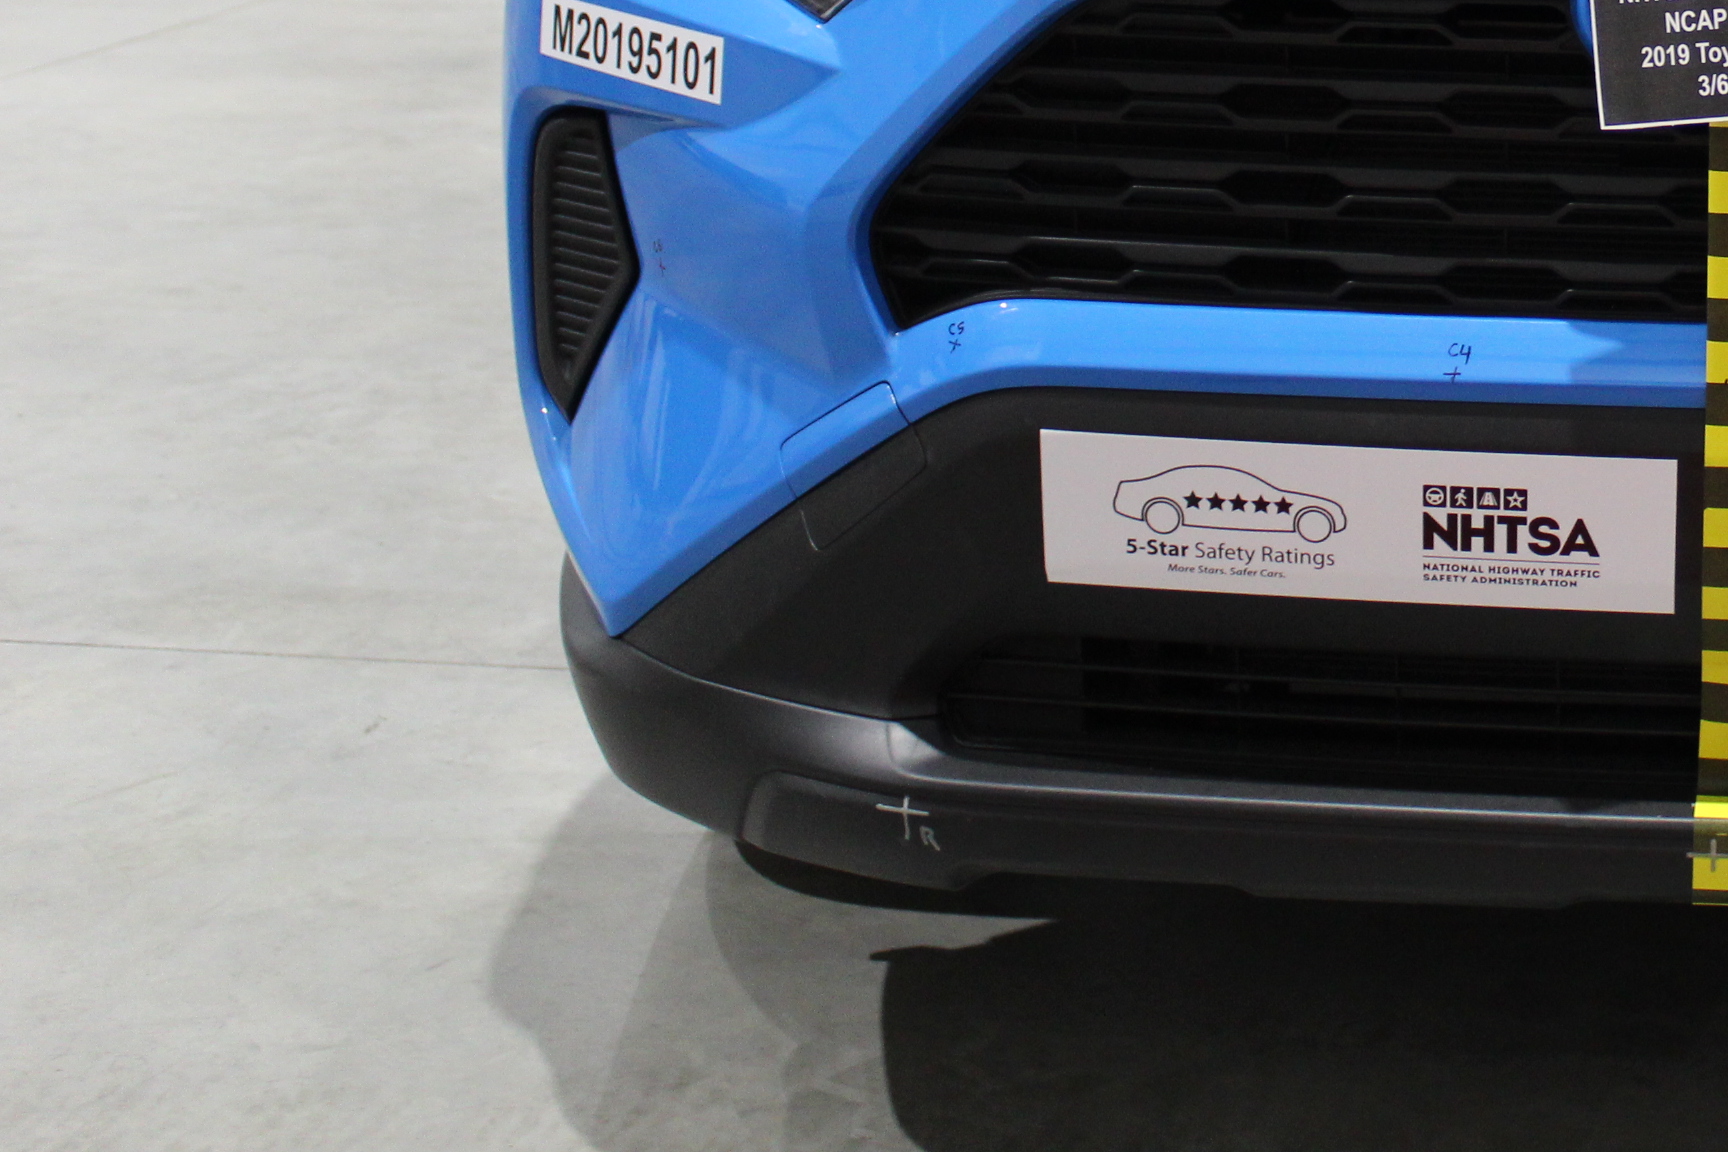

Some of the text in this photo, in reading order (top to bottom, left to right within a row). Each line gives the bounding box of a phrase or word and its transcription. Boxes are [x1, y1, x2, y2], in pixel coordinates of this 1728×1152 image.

[1665, 8, 1727, 33] NCAP
[552, 4, 716, 95] M20195101
[1641, 44, 1690, 68] 2019
[1448, 342, 1472, 365] C4
[1423, 511, 1600, 557] NHTSA
[1125, 538, 1336, 570] 5-Star Safety Ratings
[1167, 563, 1286, 579] More Stars. Safer Cars.
[1423, 563, 1601, 579] NATIONAL HIGHWAY TRAFFIC
[1423, 573, 1578, 588] SAFETY ADMINISTRATION
